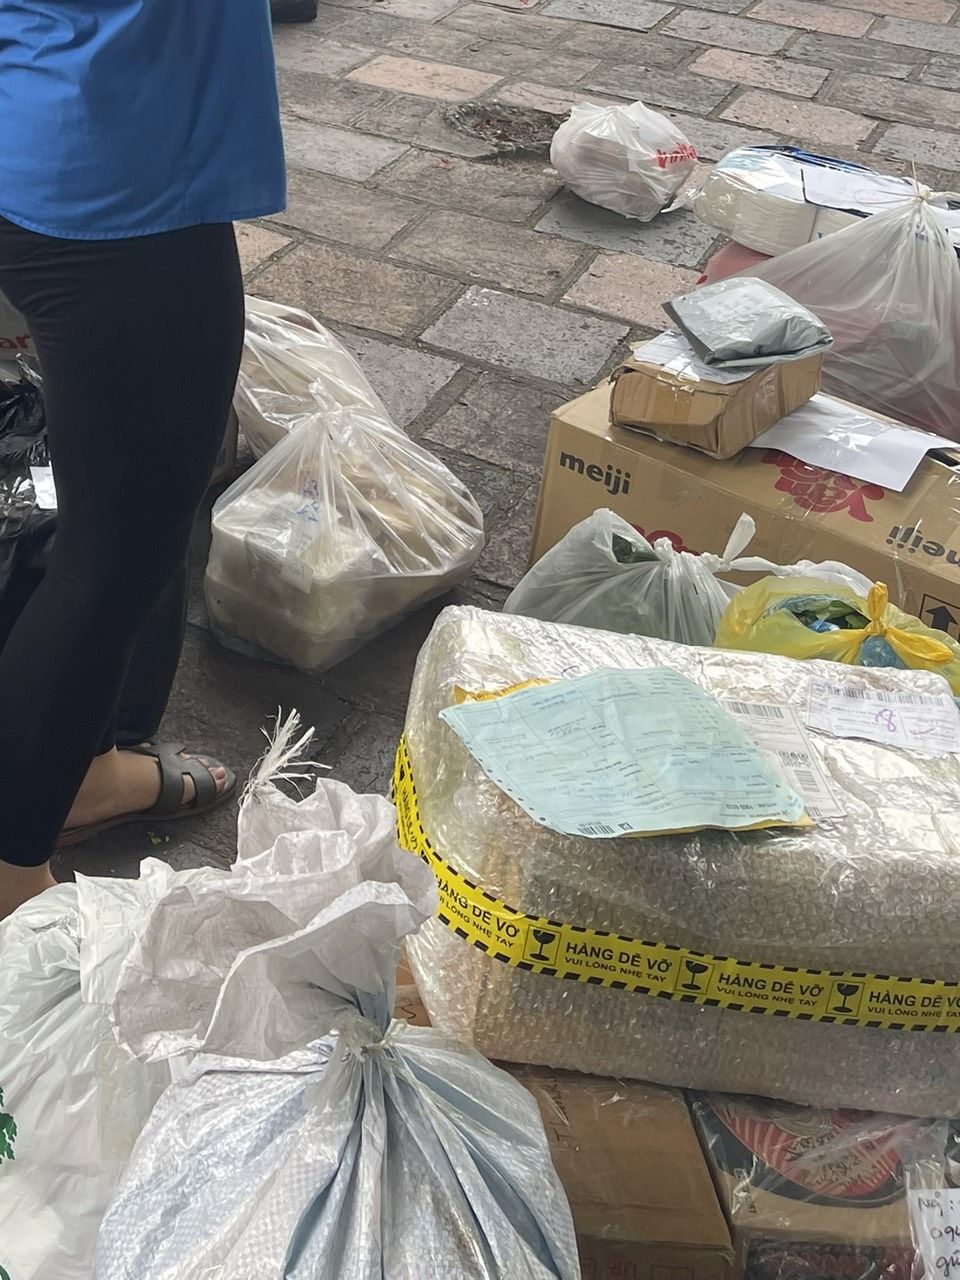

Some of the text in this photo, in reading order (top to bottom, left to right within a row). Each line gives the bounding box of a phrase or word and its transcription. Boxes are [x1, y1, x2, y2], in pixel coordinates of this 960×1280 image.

[559, 451, 632, 496] meiji
[495, 934, 515, 948] TAY
[565, 941, 614, 962] HÀNG
[564, 956, 587, 966] VUI
[646, 972, 667, 983] TAY
[718, 972, 767, 991] HÀNG
[717, 986, 736, 996] VUI
[798, 999, 818, 1007] TAY
[868, 989, 917, 1007] HÀNG
[867, 1006, 886, 1015] VUI
